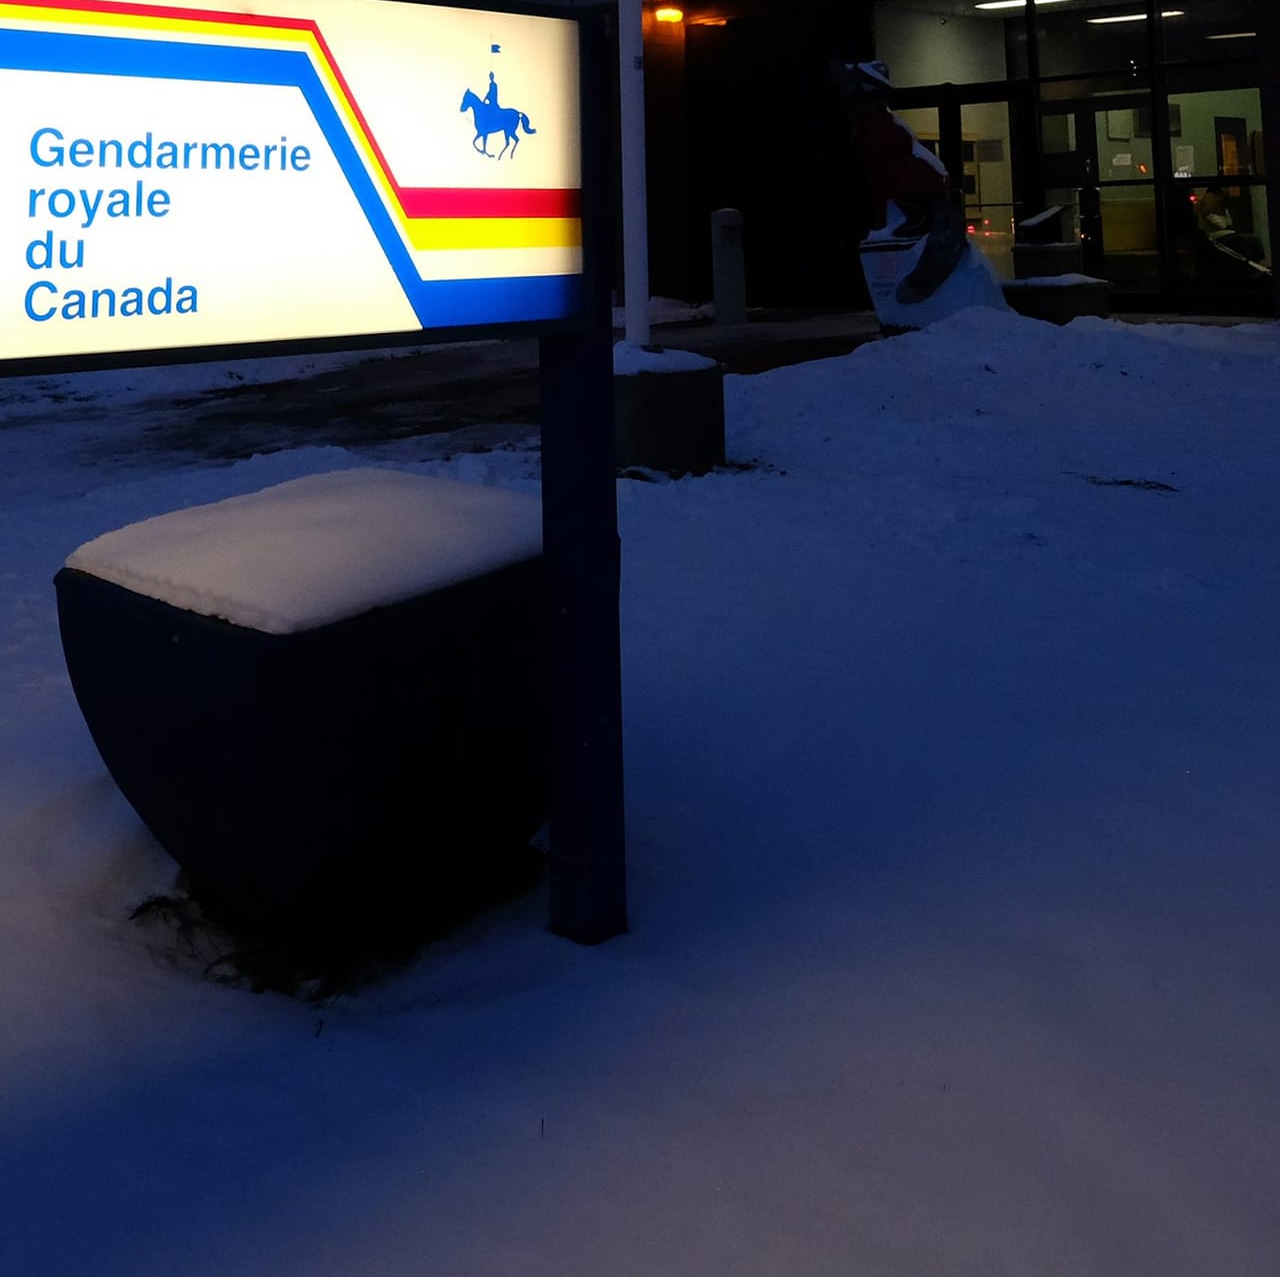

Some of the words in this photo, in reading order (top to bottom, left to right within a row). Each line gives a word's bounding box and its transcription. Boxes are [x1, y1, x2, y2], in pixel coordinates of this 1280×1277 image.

[29, 127, 312, 172] Gendarmerie
[28, 180, 171, 228] royale
[25, 230, 85, 270] du
[24, 277, 199, 322] Canada
